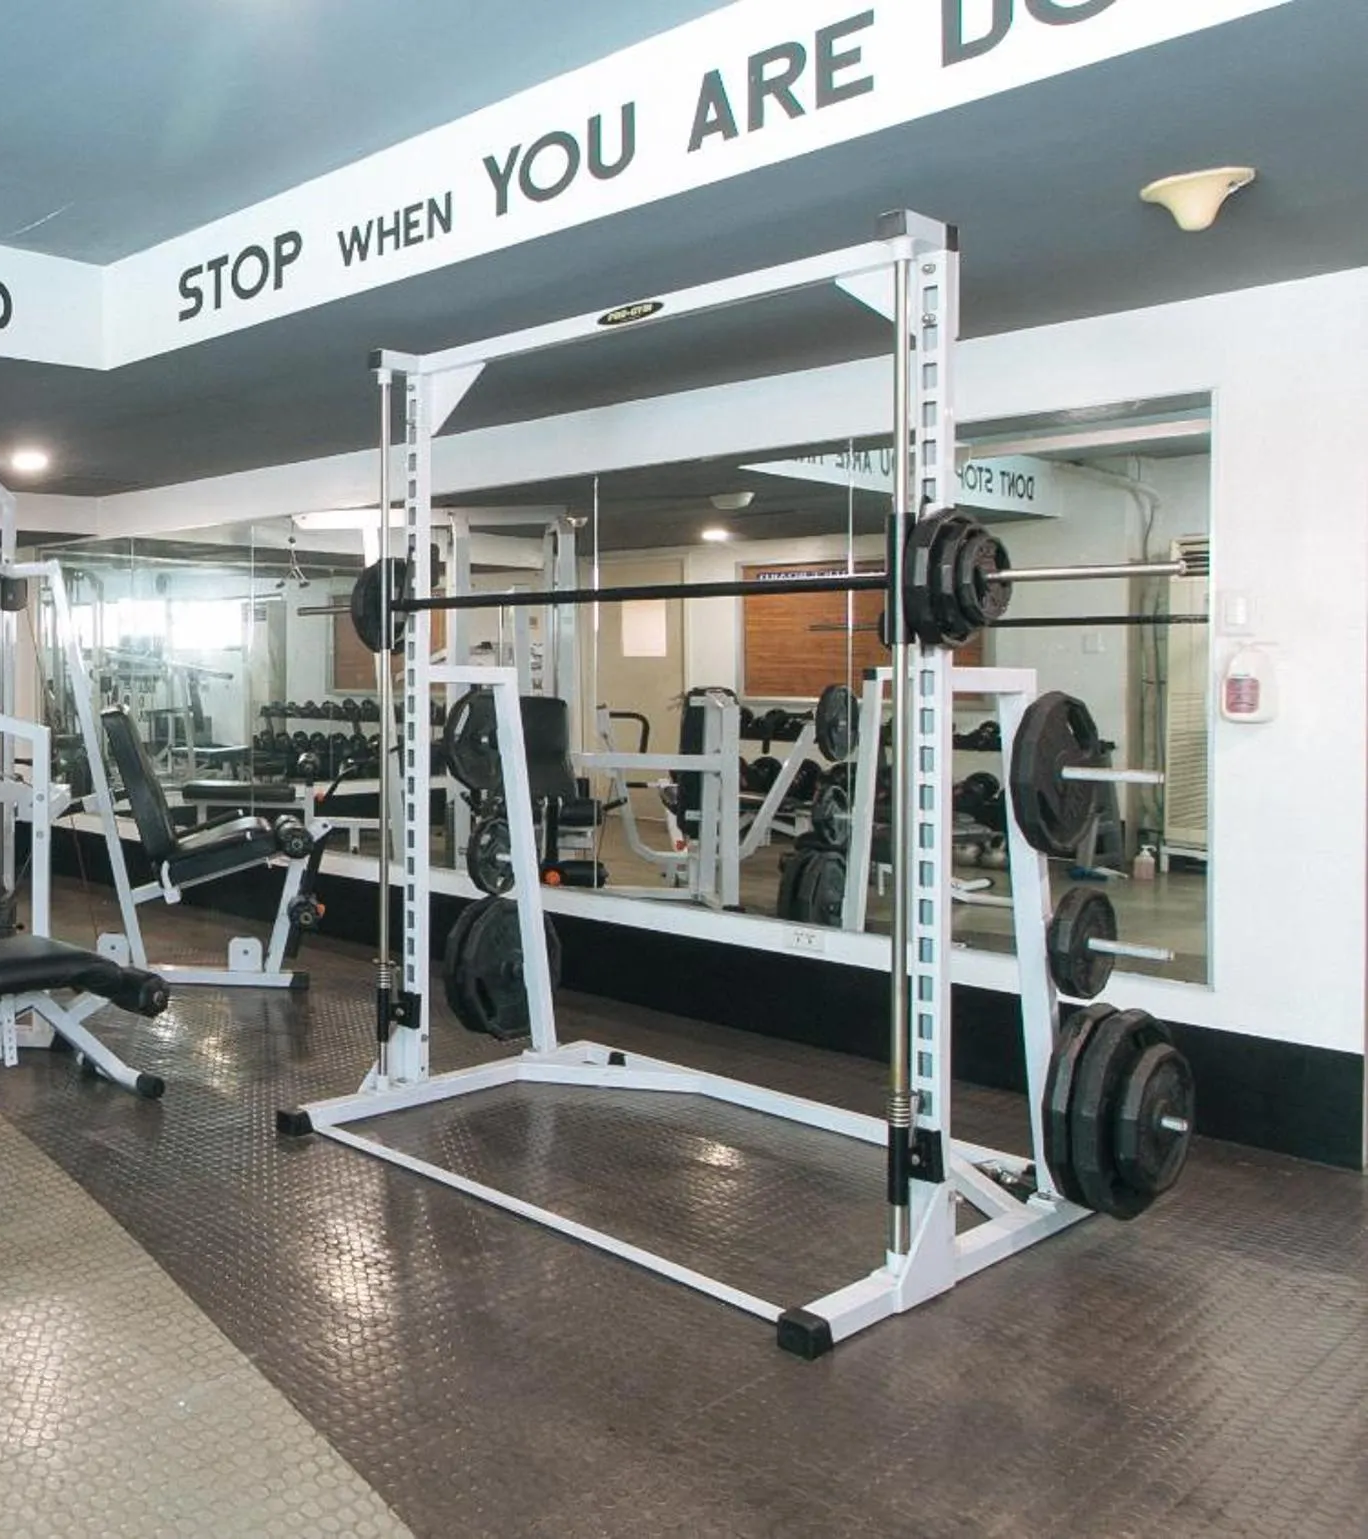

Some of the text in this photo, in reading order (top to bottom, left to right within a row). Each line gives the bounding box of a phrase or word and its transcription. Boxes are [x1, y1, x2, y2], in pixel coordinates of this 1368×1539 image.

[178, 230, 303, 322] STOP
[337, 191, 452, 267] WHEN
[482, 101, 636, 217] YOU
[687, 8, 875, 154] ARE
